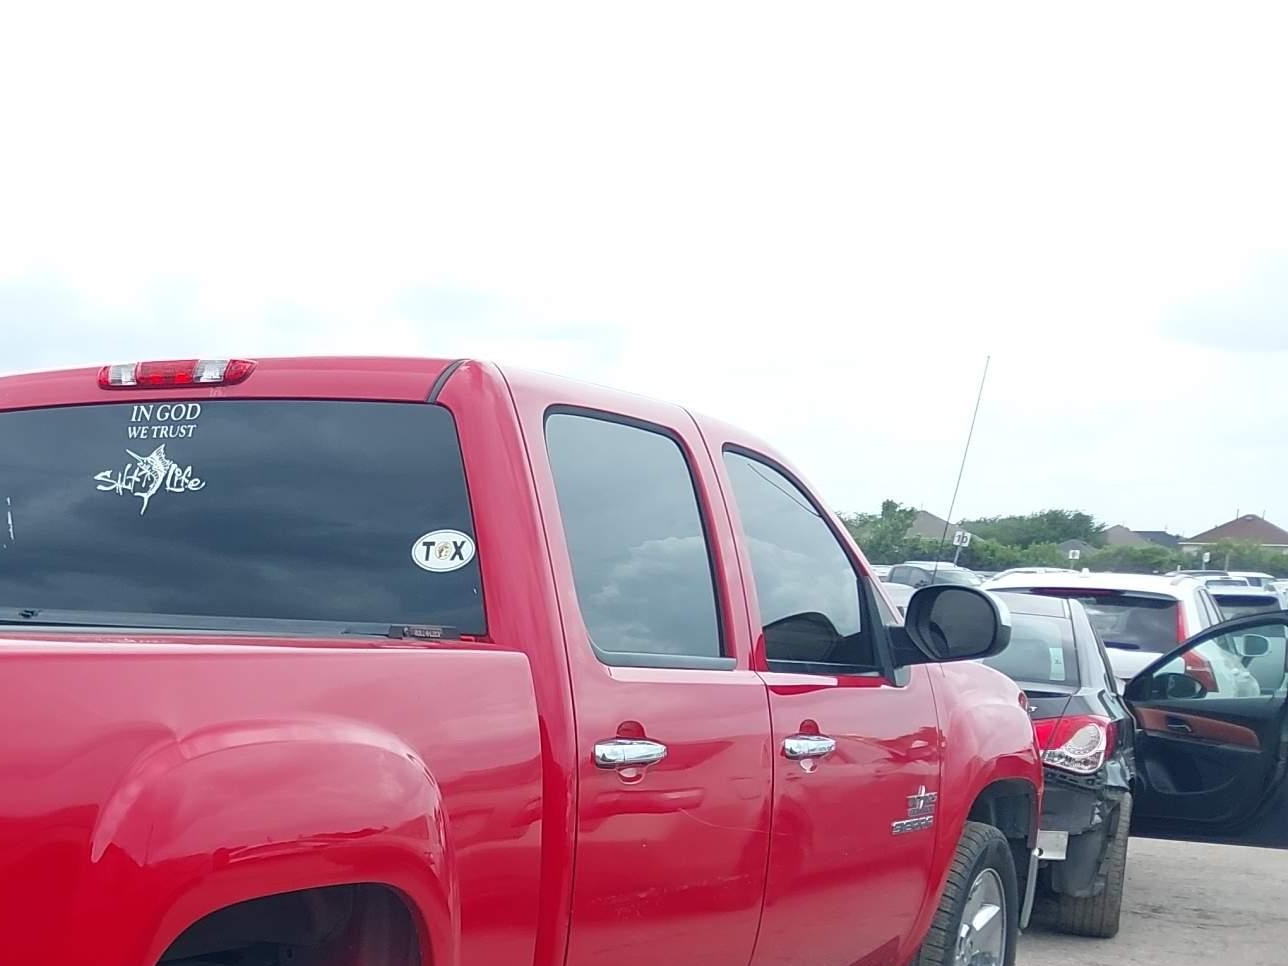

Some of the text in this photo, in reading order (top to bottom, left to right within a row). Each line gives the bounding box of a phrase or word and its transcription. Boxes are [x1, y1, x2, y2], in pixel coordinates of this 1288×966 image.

[131, 403, 201, 421] IN GOD
[127, 424, 197, 439] WE TRUST
